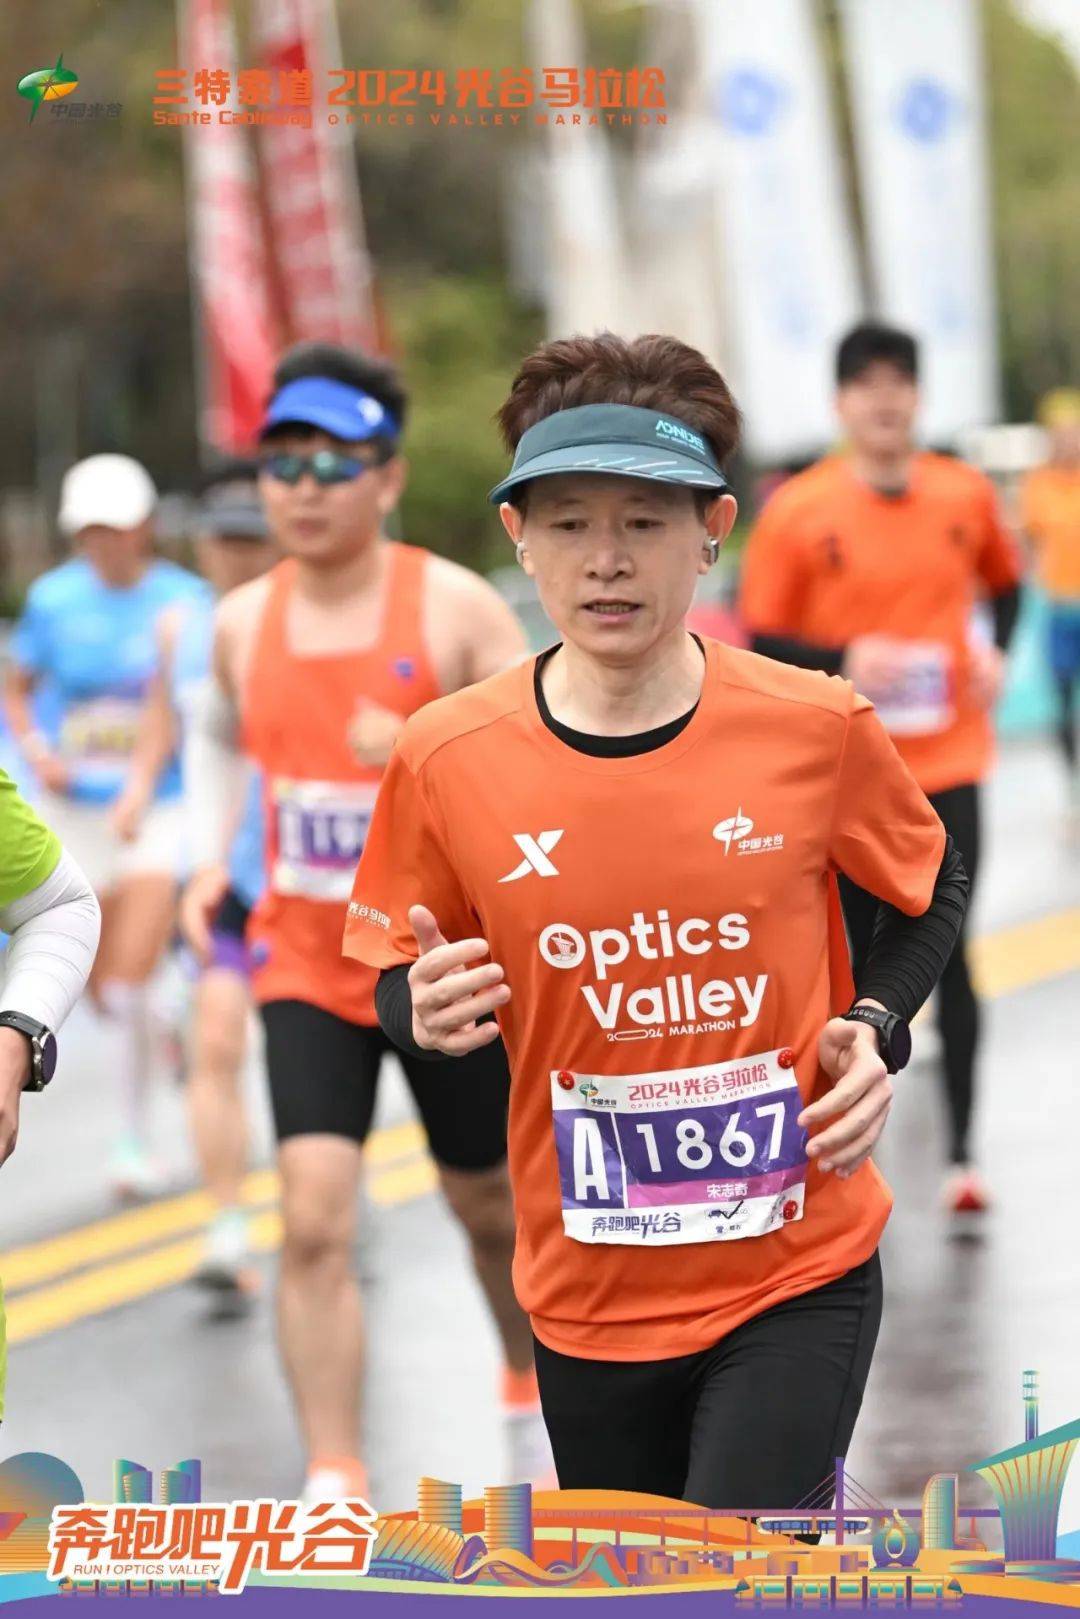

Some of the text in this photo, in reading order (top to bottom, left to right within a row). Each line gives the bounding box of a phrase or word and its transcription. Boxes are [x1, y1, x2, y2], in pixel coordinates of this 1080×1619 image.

[738, 833, 784, 850] 中国光谷
[538, 909, 751, 979] Optics
[580, 974, 768, 1029] Valley
[669, 1020, 736, 1036] MARATHON
[630, 1083, 772, 1110] OPTICS VALLEY MARATHON
[573, 1102, 785, 1200] A 1867
[591, 1212, 682, 1239] 奔跑吧光谷
